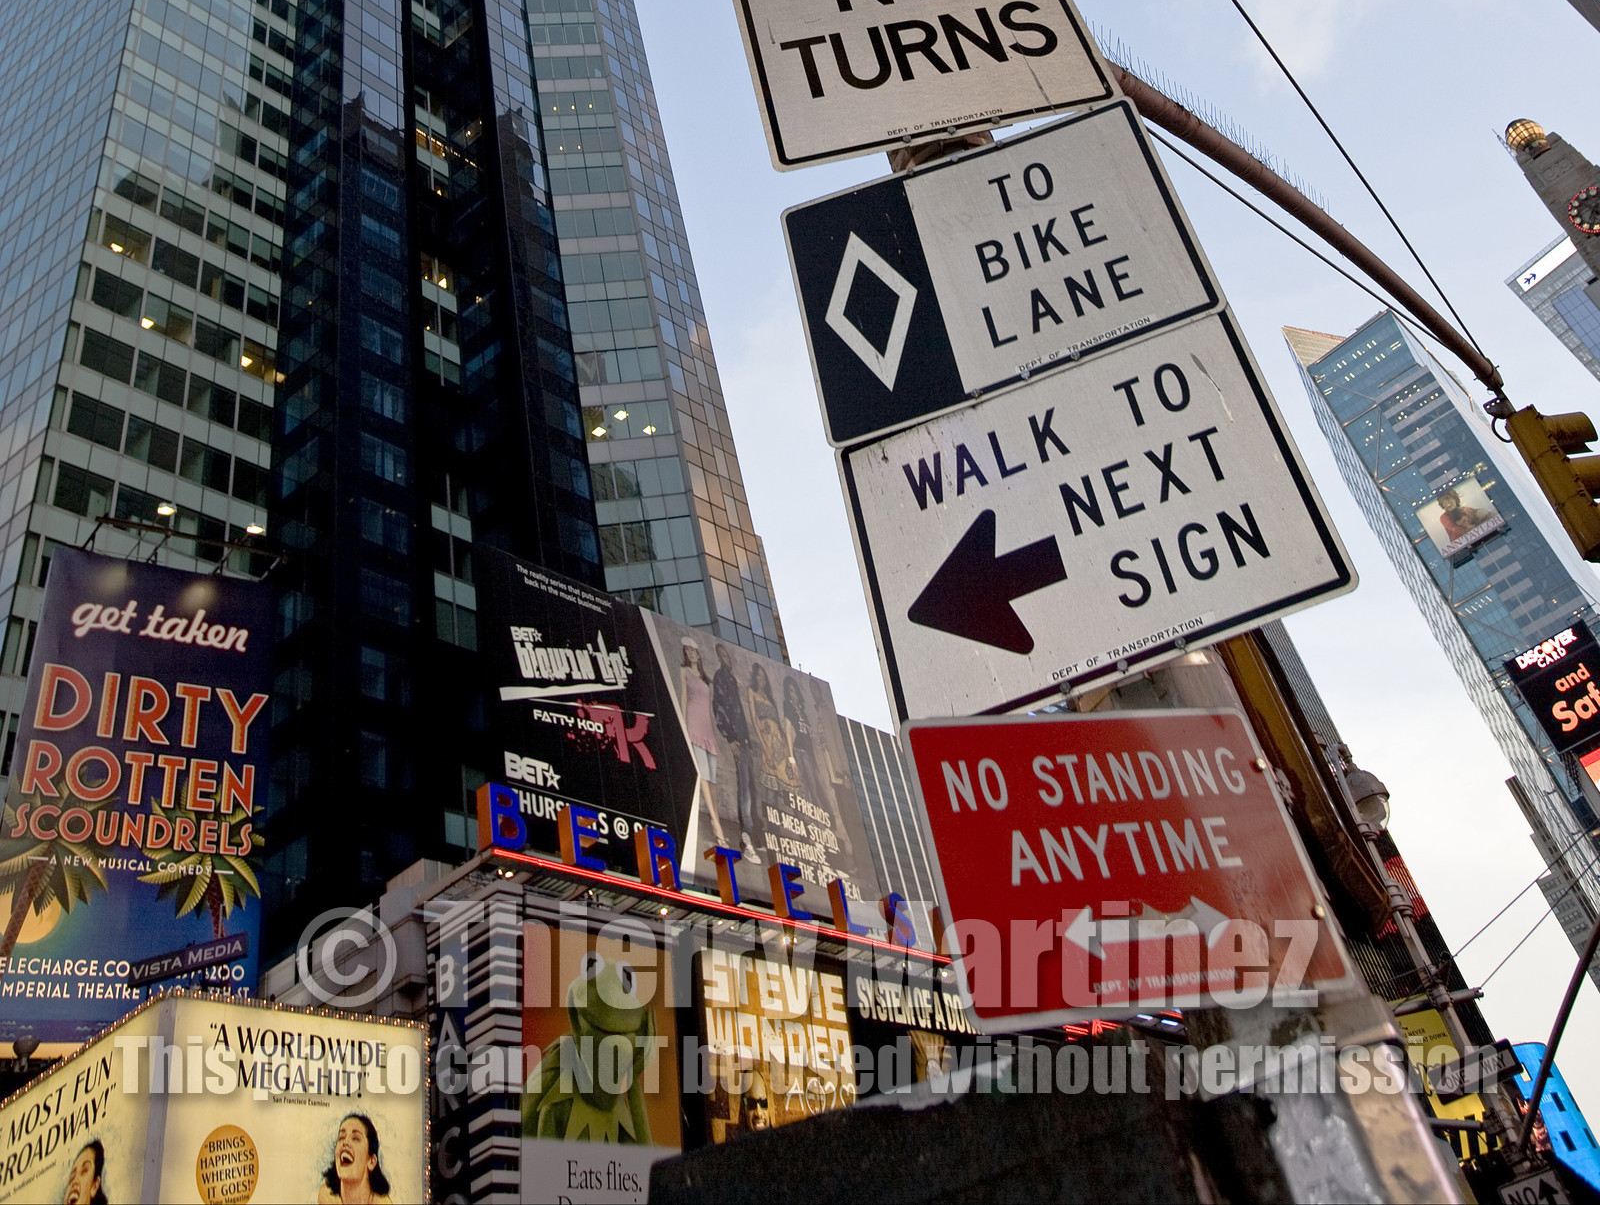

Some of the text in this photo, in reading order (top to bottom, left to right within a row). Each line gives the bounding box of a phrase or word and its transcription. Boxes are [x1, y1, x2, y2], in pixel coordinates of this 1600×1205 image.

[780, 0, 1058, 99] TURNS
[887, 108, 1003, 136] DEPT OF TRANSPORTATION
[987, 162, 1054, 212] TO
[974, 203, 1108, 284] BIKE
[980, 254, 1144, 349] LANE
[1019, 316, 1151, 372] DEPT OF TRANSPORTATION
[901, 362, 1190, 511] WALK TO
[1058, 426, 1225, 537] NEXT
[1109, 503, 1271, 608] SIGN
[516, 564, 612, 608] The reality series that puts music
[524, 576, 539, 588] back
[540, 582, 547, 591] in
[548, 586, 558, 596] the
[560, 591, 577, 603] music
[71, 599, 249, 653] get taken
[510, 626, 536, 642] BET
[1515, 628, 1578, 670] DISCOVER
[1537, 647, 1567, 668] CARD
[1555, 663, 1591, 692] and
[33, 662, 269, 754] DIRTY
[533, 709, 604, 734] FATTY KOO
[21, 739, 256, 817] ROTTEN
[504, 751, 549, 787] BET
[940, 747, 1246, 813] NO STANDING
[11, 803, 252, 856] SCOUNDRELS
[614, 818, 629, 839] @
[766, 806, 781, 826] NO
[781, 812, 807, 838] MEGA
[789, 793, 831, 828] 5 FRIENDS
[765, 832, 780, 851] NO
[1011, 816, 1243, 886] ANYTIME
[49, 855, 213, 875] A NEW MUSICAL COMEDY
[798, 861, 816, 884] THE
[132, 955, 182, 980] VISTA
[188, 940, 242, 964] MEDIA
[0, 980, 70, 998] MPERIAL
[78, 982, 140, 1000] THEATRE
[701, 946, 847, 1023] STEVIE
[1093, 967, 1238, 994] DEPT. OF TRANSPORTATION
[856, 976, 916, 1026] SYSTEM
[913, 987, 932, 1029] OF
[933, 991, 947, 1031] A
[237, 1026, 386, 1069] WORLDWIDE
[705, 1007, 853, 1075] WONDER
[1445, 1053, 1507, 1089] ONE WAY
[7, 1051, 113, 1149] MOST FUN
[272, 1095, 330, 1108] San Francisco Examiner
[200, 1148, 255, 1170] HAPPINESS
[202, 1164, 255, 1185] WHEREVER
[567, 1160, 642, 1192] Eats flies.
[207, 1186, 216, 1200] IT
